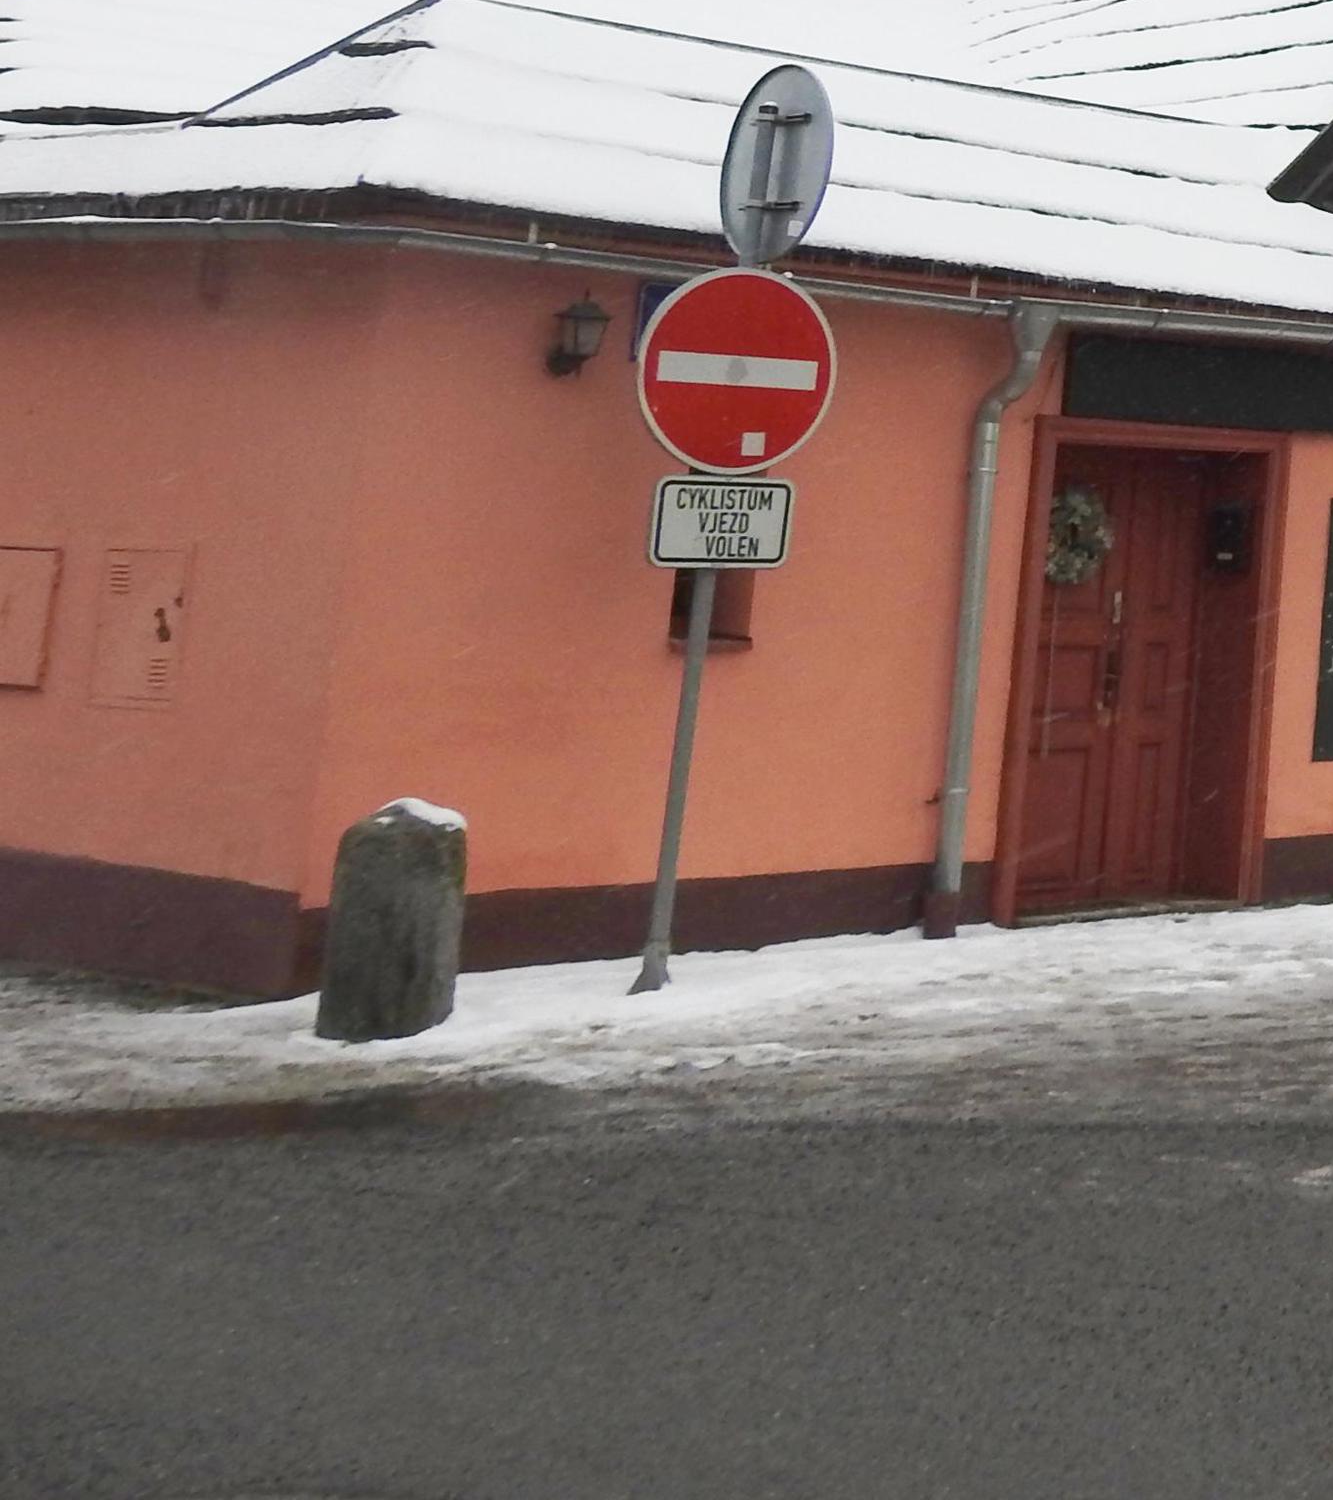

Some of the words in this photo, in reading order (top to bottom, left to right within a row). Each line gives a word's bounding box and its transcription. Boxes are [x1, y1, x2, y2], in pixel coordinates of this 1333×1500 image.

[676, 487, 774, 511] CYKLISTUM
[698, 512, 749, 534] VJEZD
[705, 535, 759, 557] VOLEN
